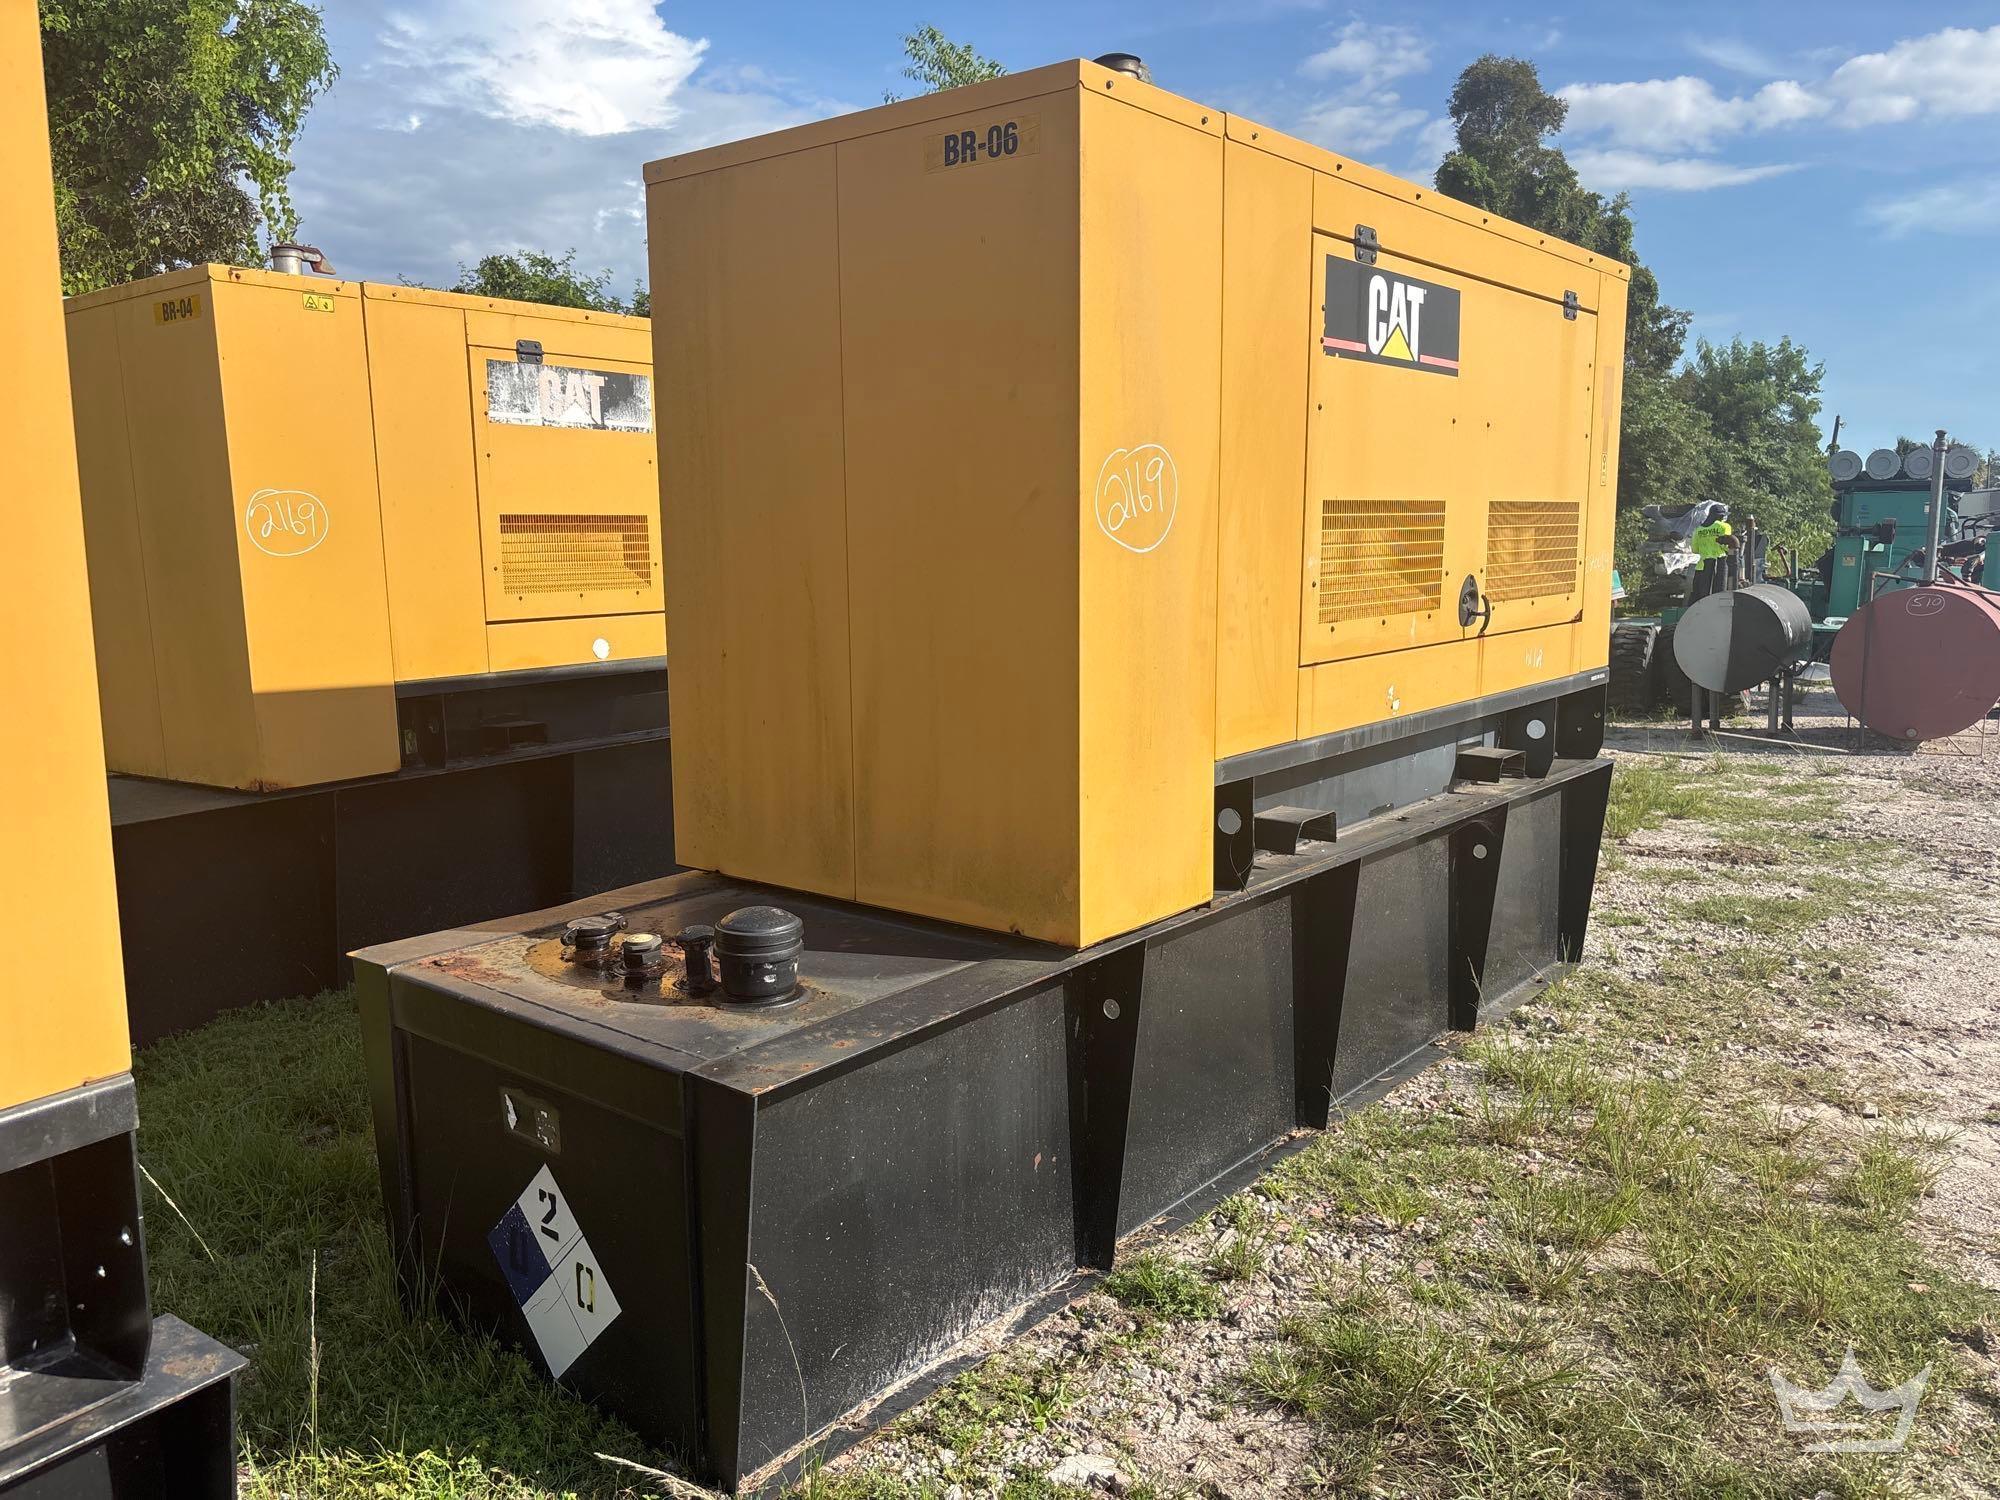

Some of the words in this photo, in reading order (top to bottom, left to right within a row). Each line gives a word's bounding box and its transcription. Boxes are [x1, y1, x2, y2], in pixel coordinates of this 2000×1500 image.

[944, 121, 1018, 167] BR-06
[162, 298, 193, 321] BR-04
[1368, 274, 1425, 362] CAT
[1103, 456, 1164, 531] 2169
[250, 499, 316, 538] 2169
[1911, 596, 1942, 607] 510
[538, 1188, 559, 1242] 2
[576, 1261, 594, 1313] 0
